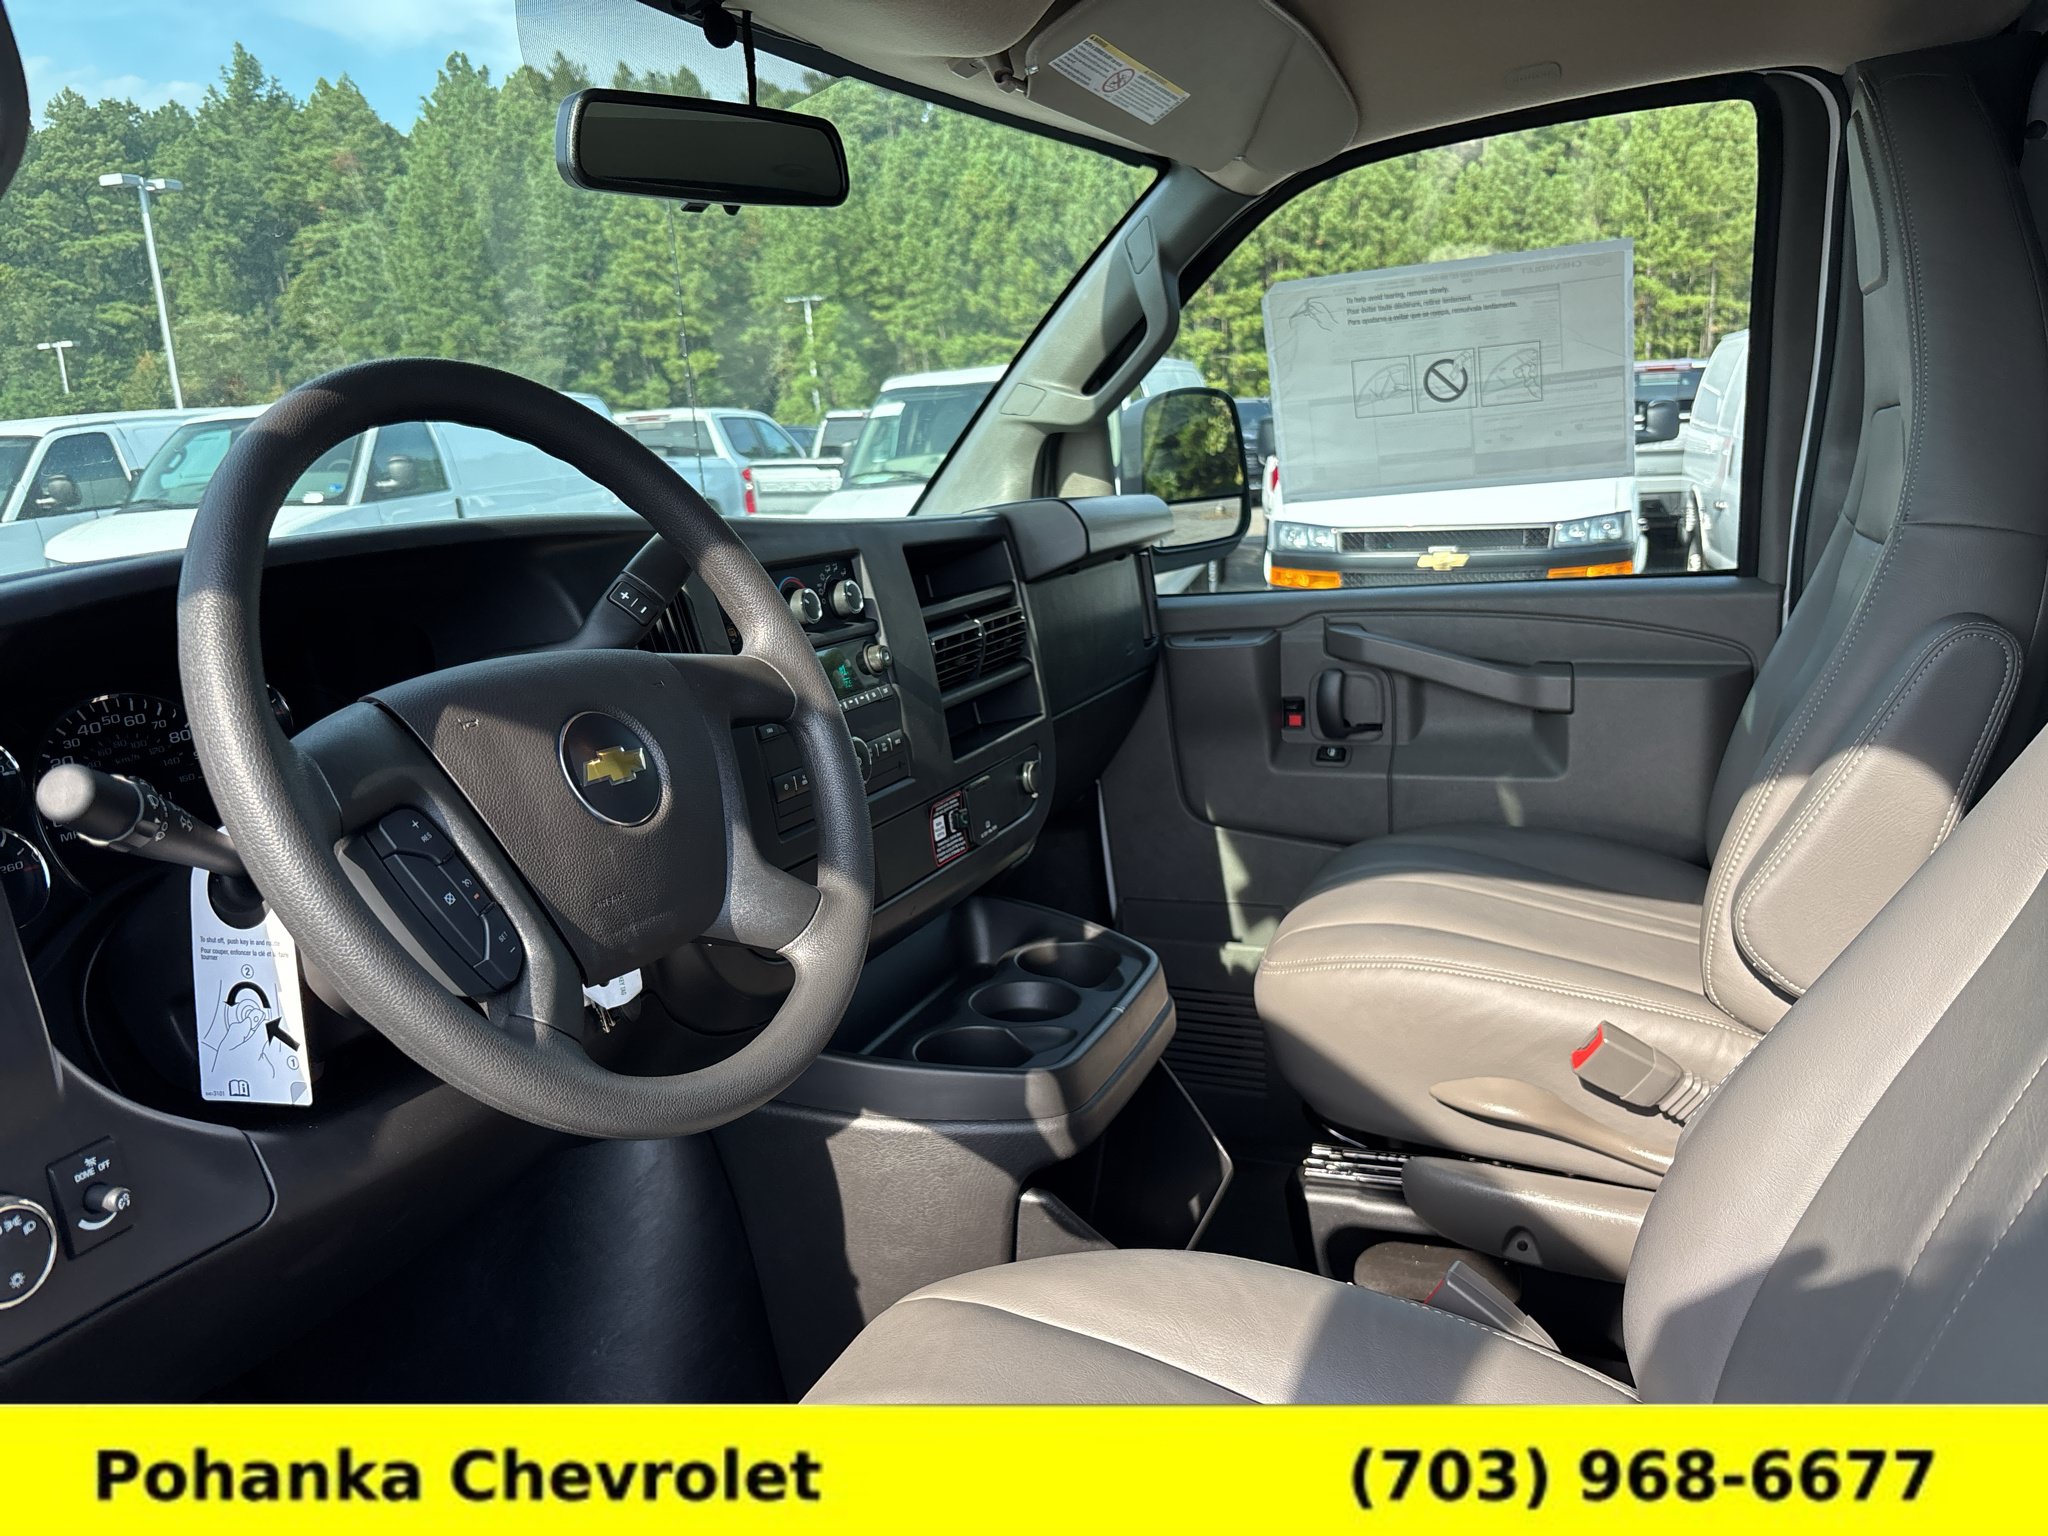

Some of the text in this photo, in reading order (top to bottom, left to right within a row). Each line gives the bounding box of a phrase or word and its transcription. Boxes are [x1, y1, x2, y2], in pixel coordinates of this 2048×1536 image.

[102, 713, 121, 726] 50
[124, 713, 146, 727] 60
[151, 719, 167, 730] 70
[77, 721, 101, 737] 40
[169, 729, 192, 744] 80
[63, 738, 81, 749] 30
[163, 756, 180, 767] 140
[421, 832, 433, 842] RES
[227, 938, 239, 946] push
[239, 938, 249, 946] key
[74, 1159, 110, 1184] DOME OFF
